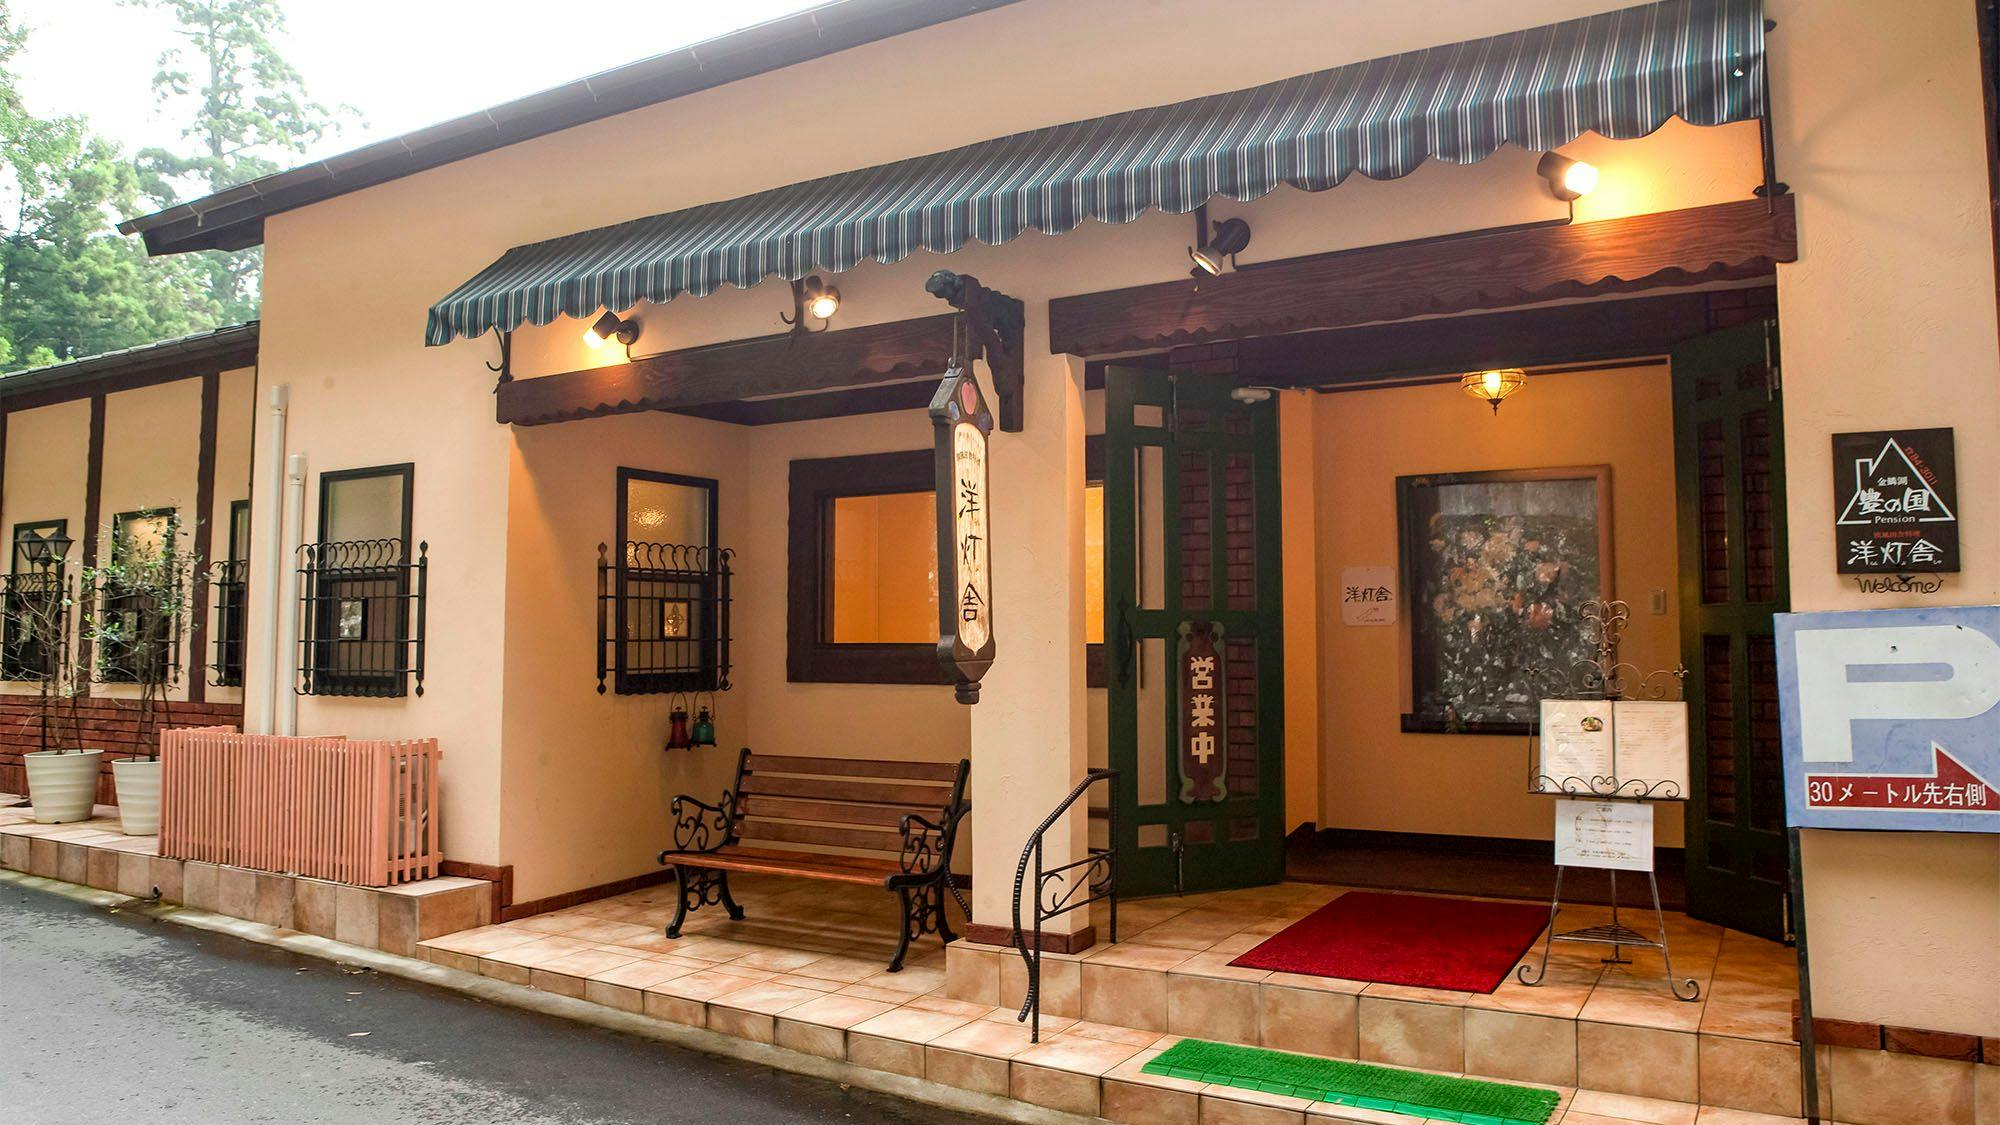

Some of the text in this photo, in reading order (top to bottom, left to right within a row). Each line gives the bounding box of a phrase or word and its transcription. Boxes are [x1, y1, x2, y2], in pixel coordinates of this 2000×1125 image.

[1858, 487, 1931, 515] 豊の国
[1874, 515, 1916, 524] Pension
[958, 478, 984, 622] 洋灯舎
[1847, 538, 1944, 566] 洋灯舎
[1344, 586, 1393, 603] 洋灯舎
[1854, 576, 1945, 594] Welcome
[1794, 625, 2000, 763] P
[1190, 656, 1215, 764] 営業中
